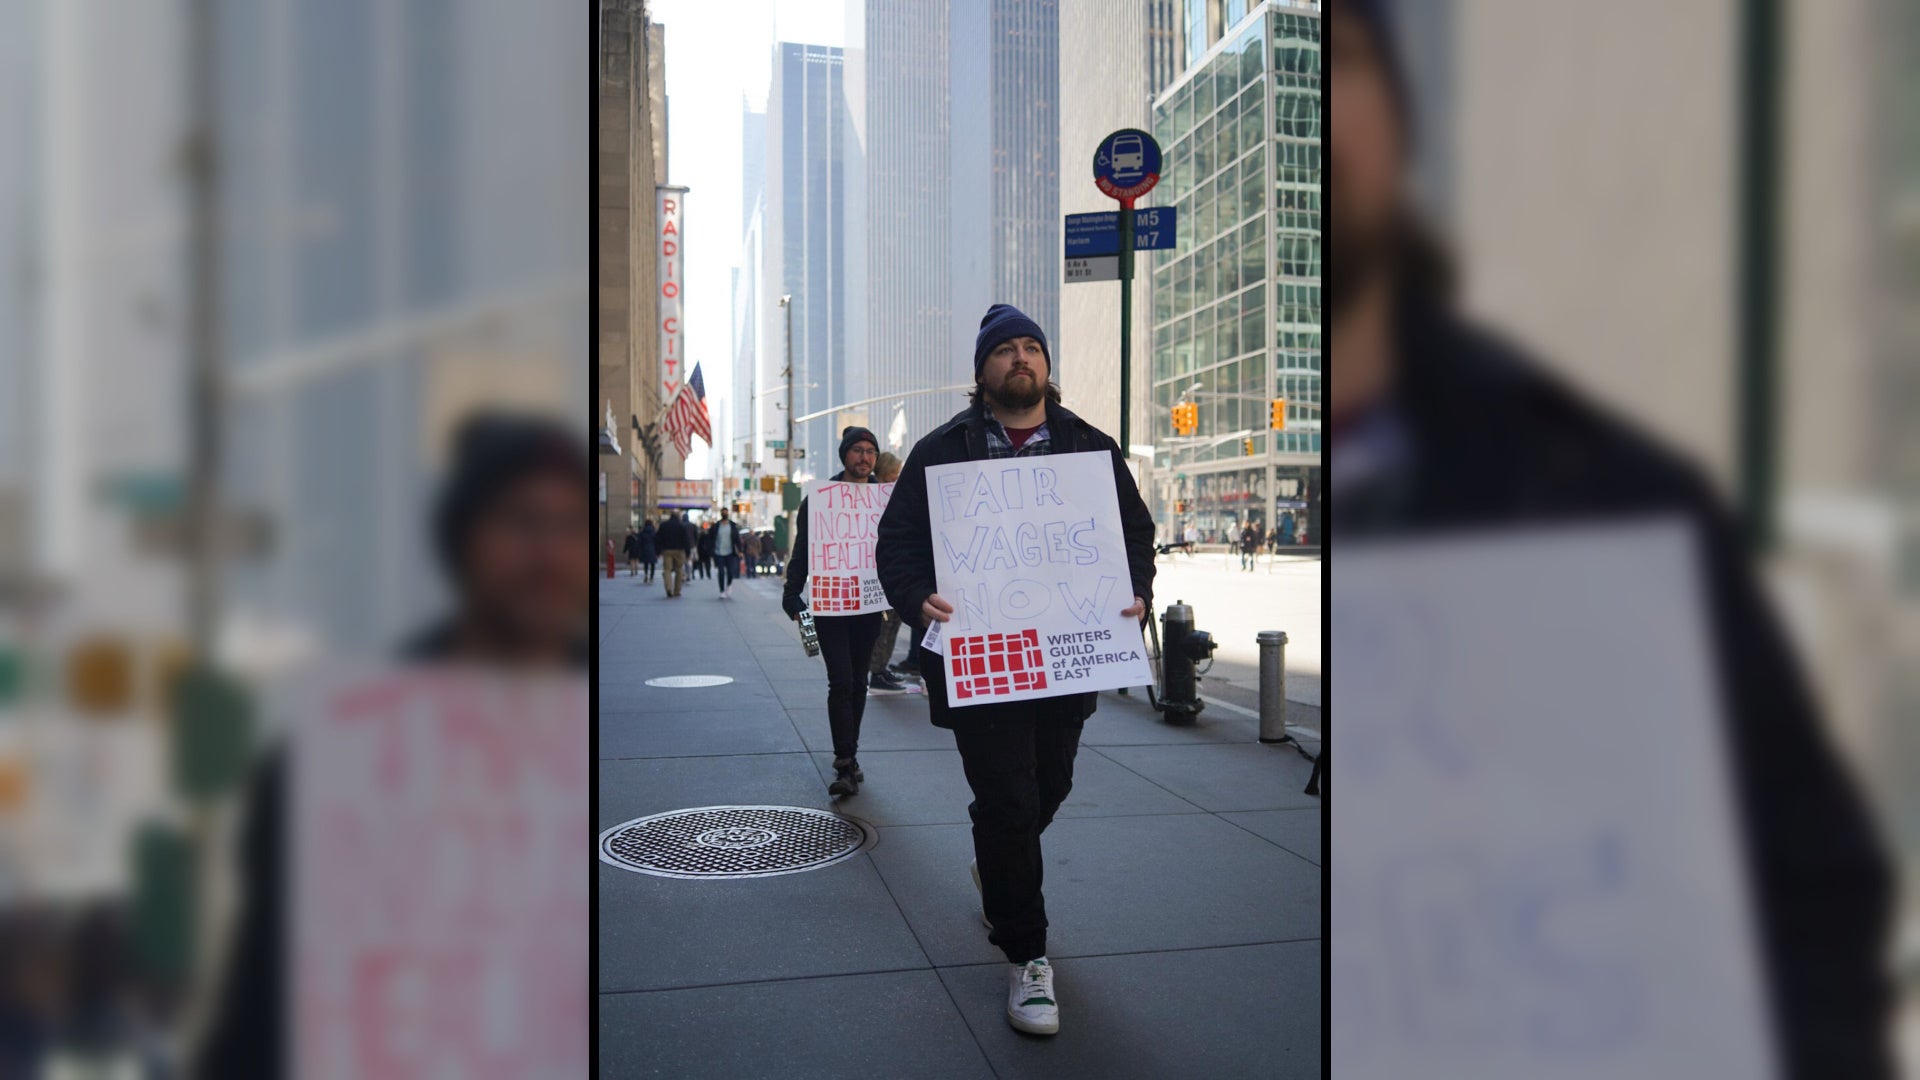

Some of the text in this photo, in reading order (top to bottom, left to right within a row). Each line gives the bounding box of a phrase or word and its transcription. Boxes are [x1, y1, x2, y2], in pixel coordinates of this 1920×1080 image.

[1111, 176, 1155, 197] STANDING
[1137, 210, 1159, 226] M5
[1137, 231, 1159, 248] M7
[662, 199, 680, 396] RADIO CITY
[817, 483, 894, 509] TRANS
[938, 467, 1064, 523] FAIR
[814, 511, 880, 541] INCLUS
[939, 517, 1099, 574] WAGES
[811, 541, 877, 571] HEALTH
[863, 585, 882, 593] GUIL
[863, 597, 883, 606] EAST
[955, 576, 1118, 631] NOW
[1047, 629, 1112, 646] WRITERS
[1050, 644, 1095, 657] GUILD
[1052, 650, 1140, 669] of AMERICA
[1054, 667, 1091, 681] EAST
